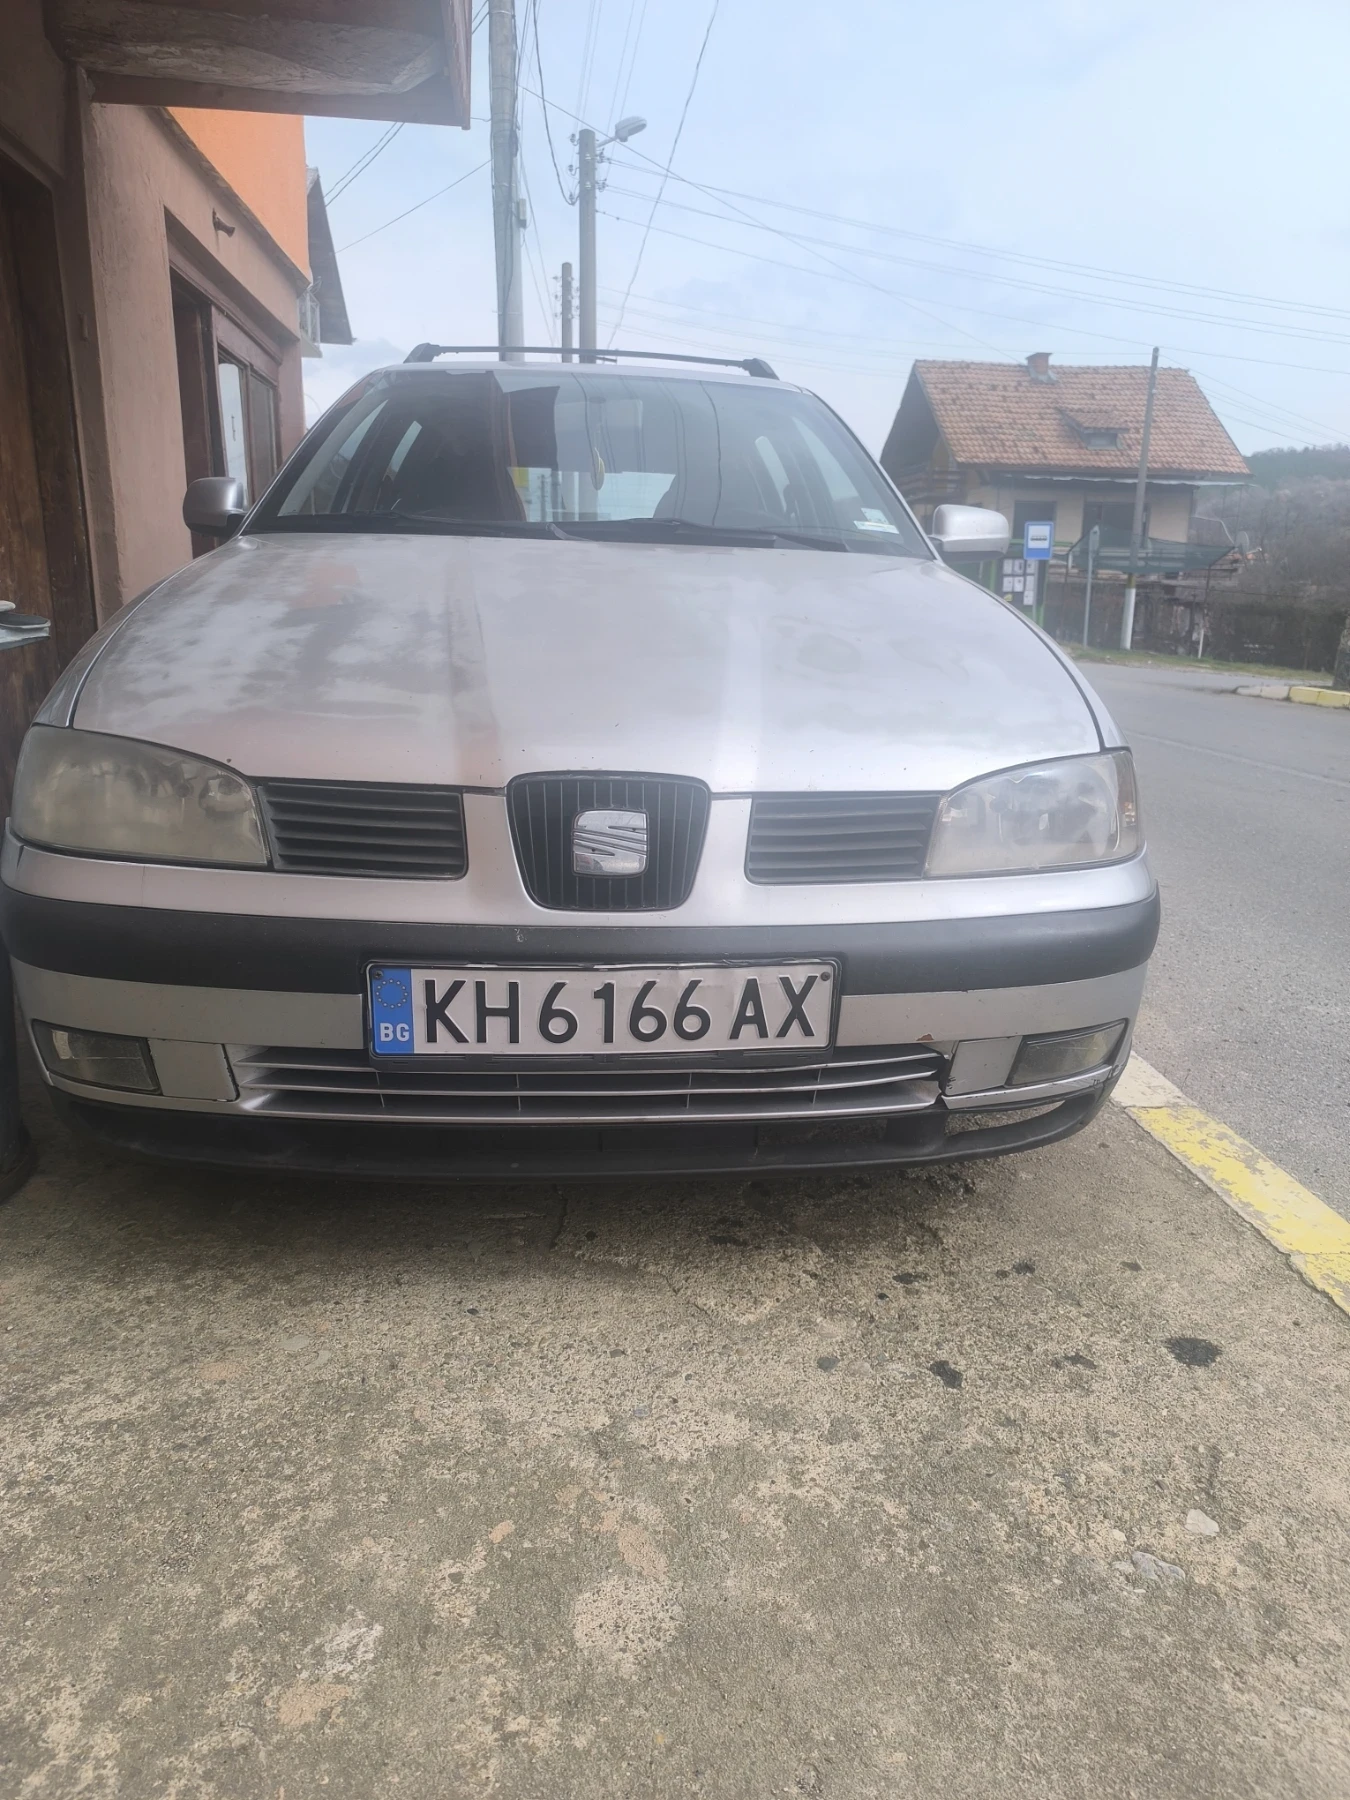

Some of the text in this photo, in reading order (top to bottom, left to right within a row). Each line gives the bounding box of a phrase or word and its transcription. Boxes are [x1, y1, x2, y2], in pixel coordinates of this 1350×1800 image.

[424, 975, 819, 1044] KH 6166 AX
[380, 1023, 410, 1042] BG
